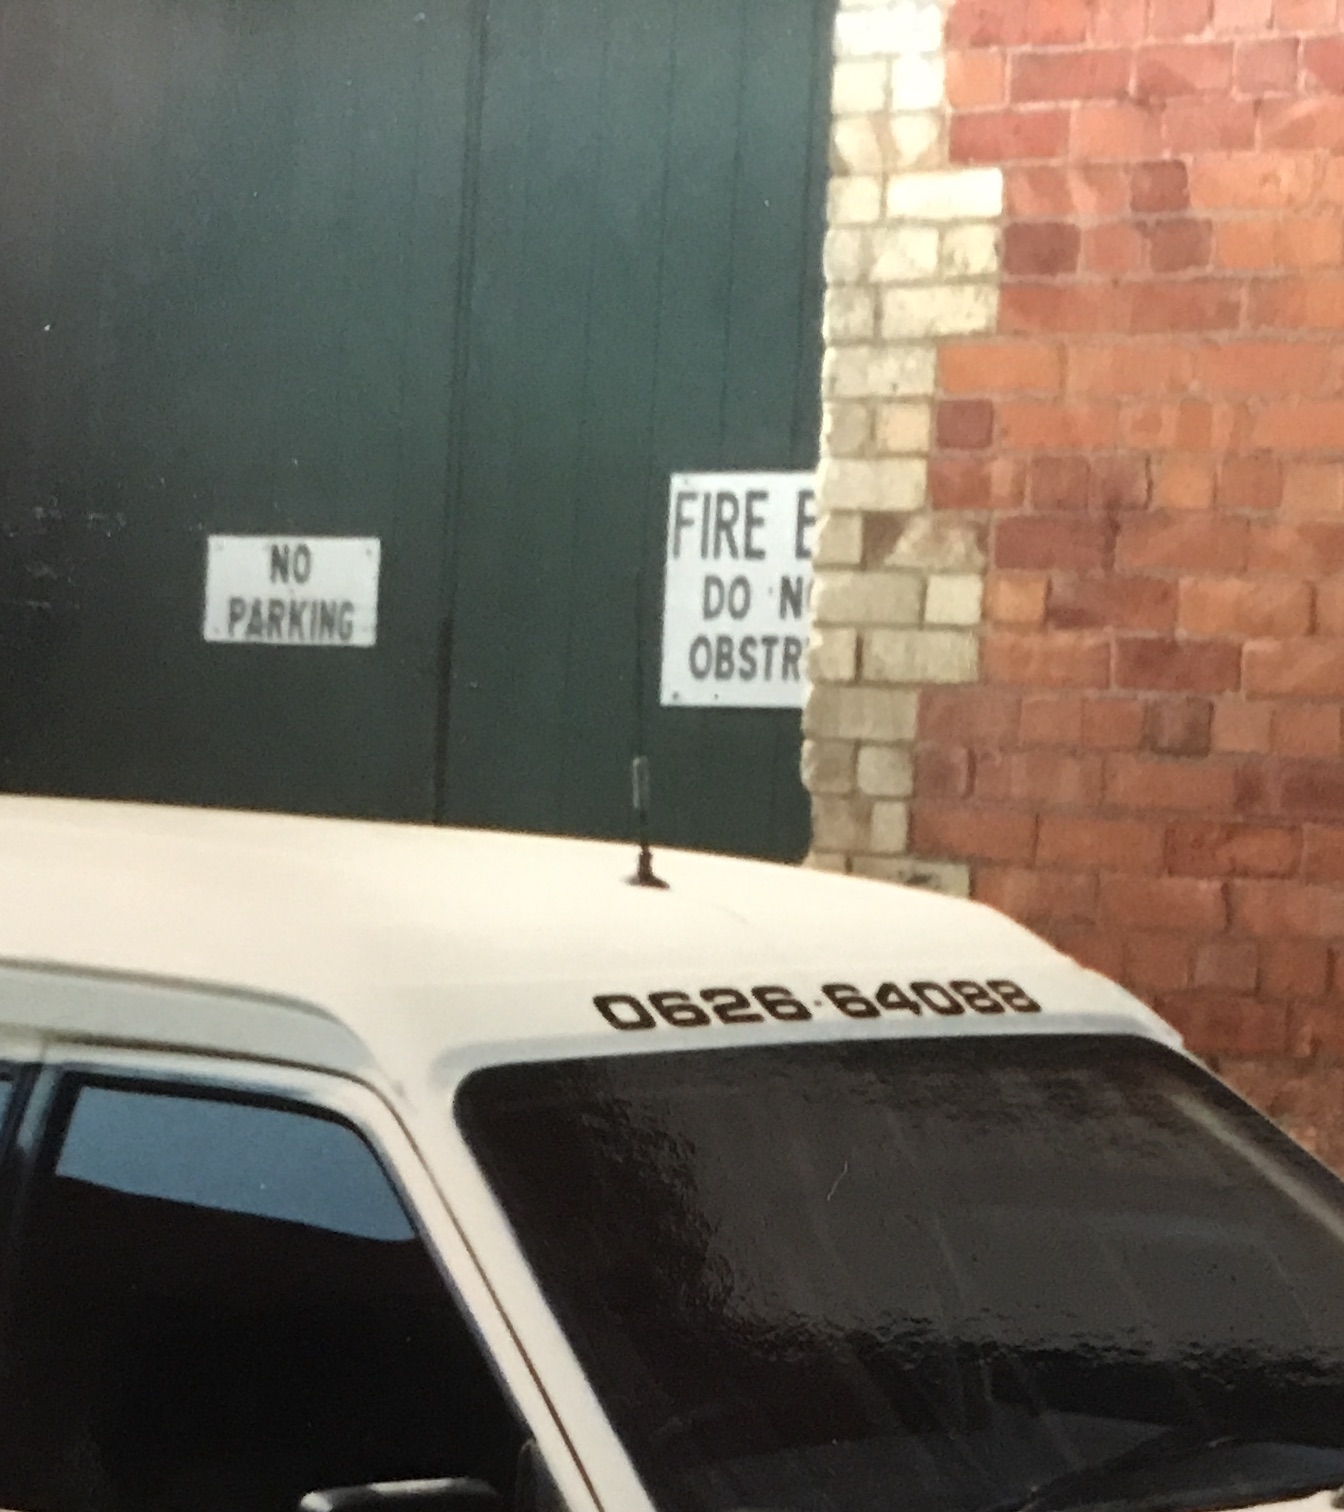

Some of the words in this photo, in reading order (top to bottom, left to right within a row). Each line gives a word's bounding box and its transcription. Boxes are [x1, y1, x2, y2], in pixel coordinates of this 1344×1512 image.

[672, 490, 769, 560] FIRE
[270, 543, 311, 584] NO
[228, 597, 355, 641] PARKING
[703, 575, 751, 620] DO
[689, 634, 810, 681] OBSTR
